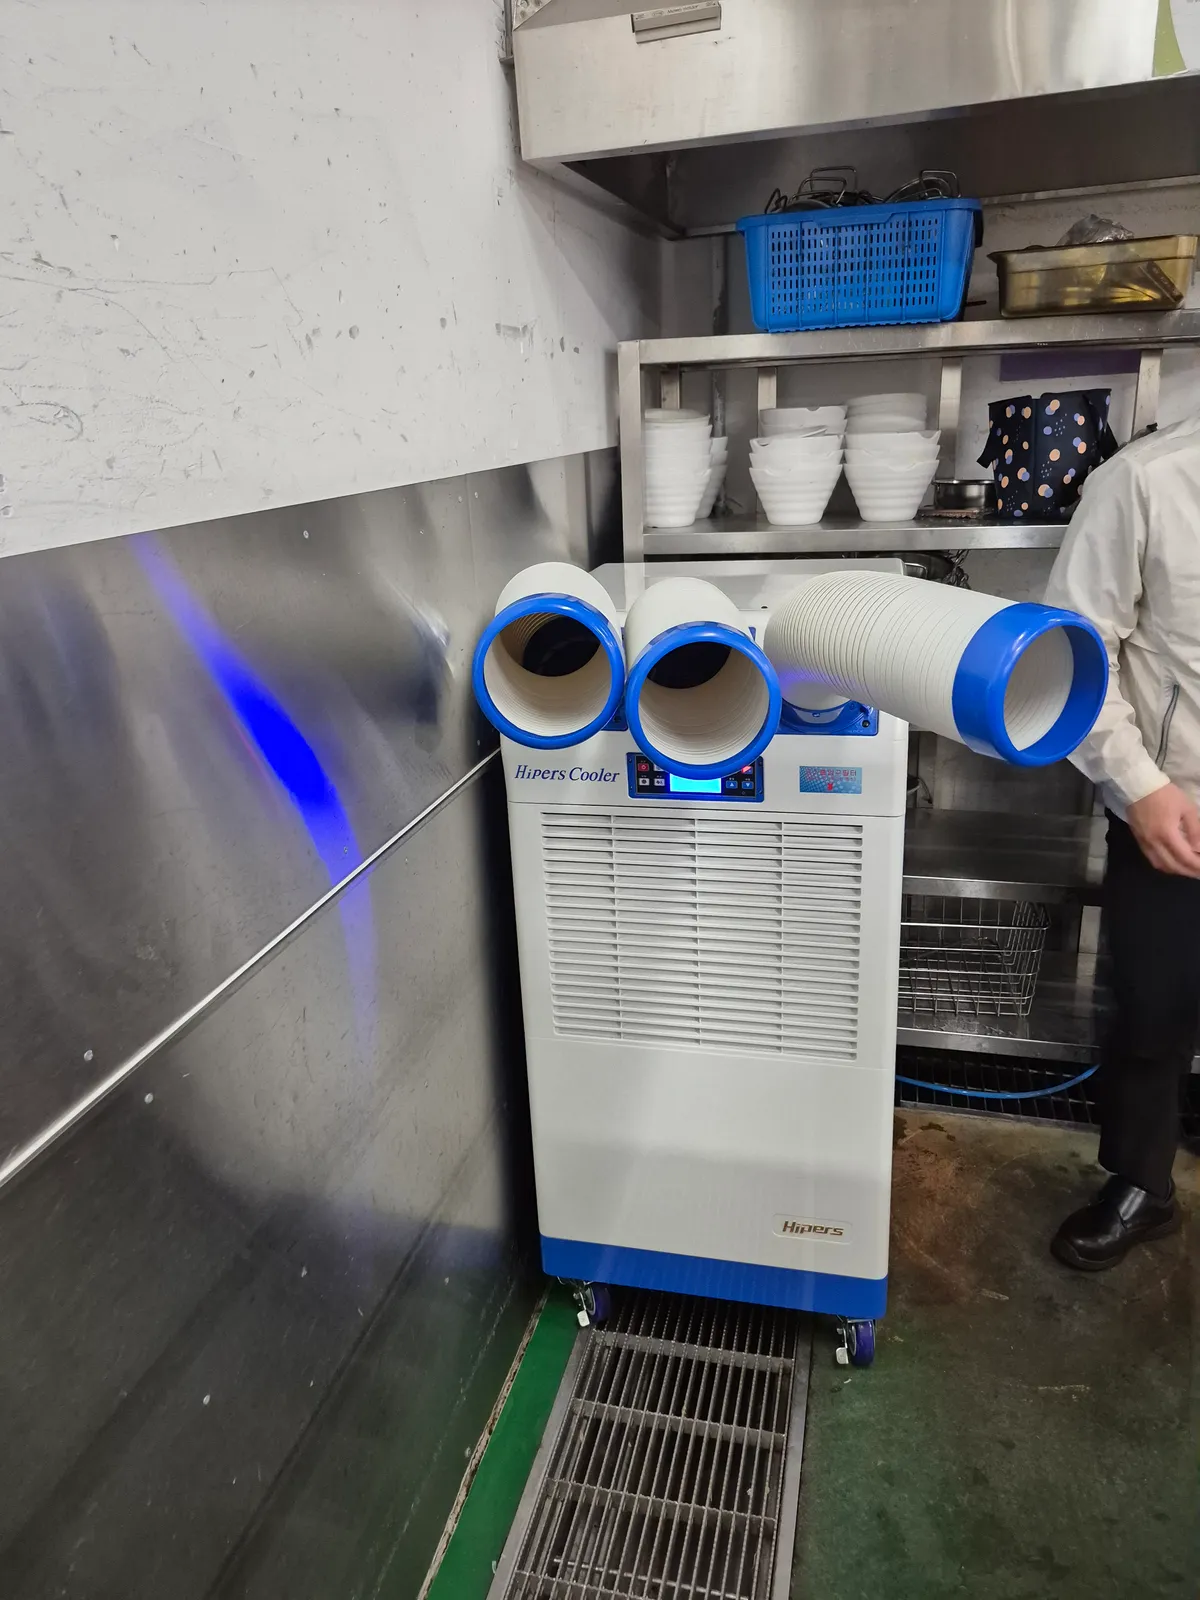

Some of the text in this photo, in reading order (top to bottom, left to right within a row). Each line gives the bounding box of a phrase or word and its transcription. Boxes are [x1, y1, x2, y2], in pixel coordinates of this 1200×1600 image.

[514, 764, 620, 783] Hipers Cooler
[782, 1220, 845, 1236] Hipers
